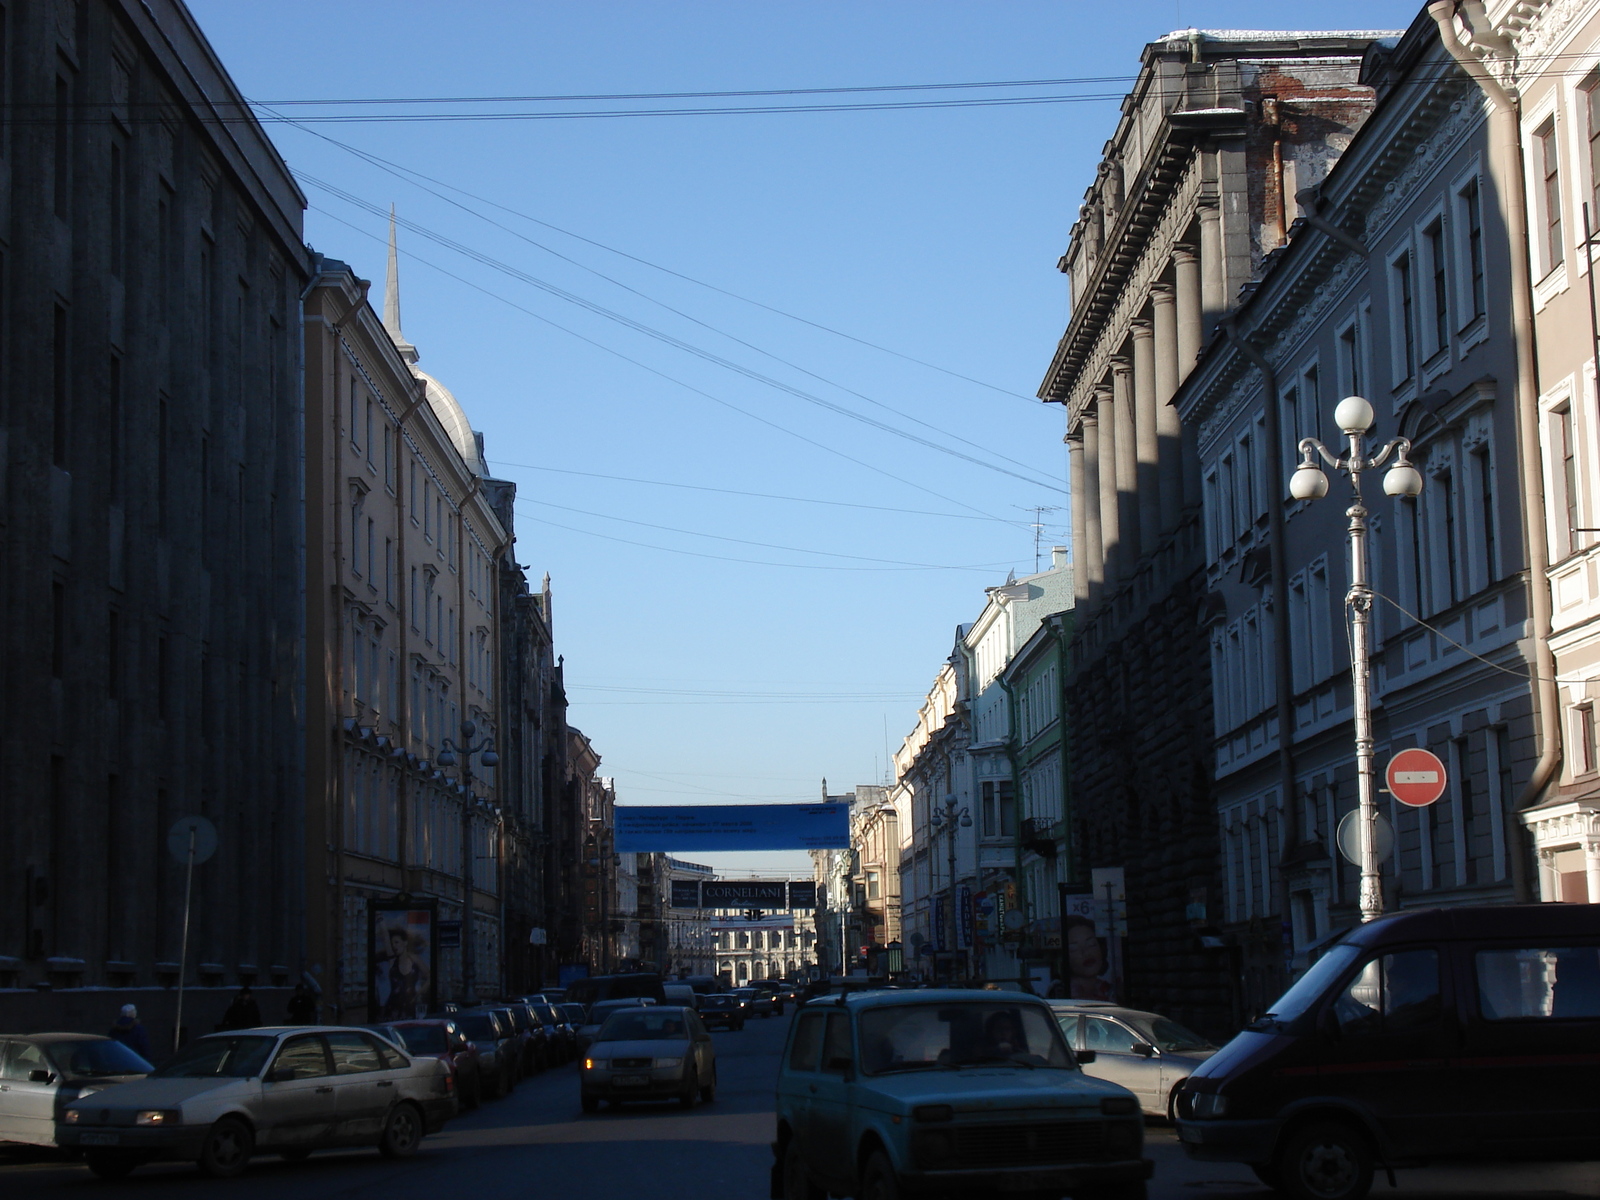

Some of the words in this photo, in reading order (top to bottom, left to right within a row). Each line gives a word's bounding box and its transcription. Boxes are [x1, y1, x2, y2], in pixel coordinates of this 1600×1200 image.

[706, 887, 781, 898] CORNELIANI
[963, 890, 971, 943] DIADEMA
[1044, 936, 1060, 946] Lee
